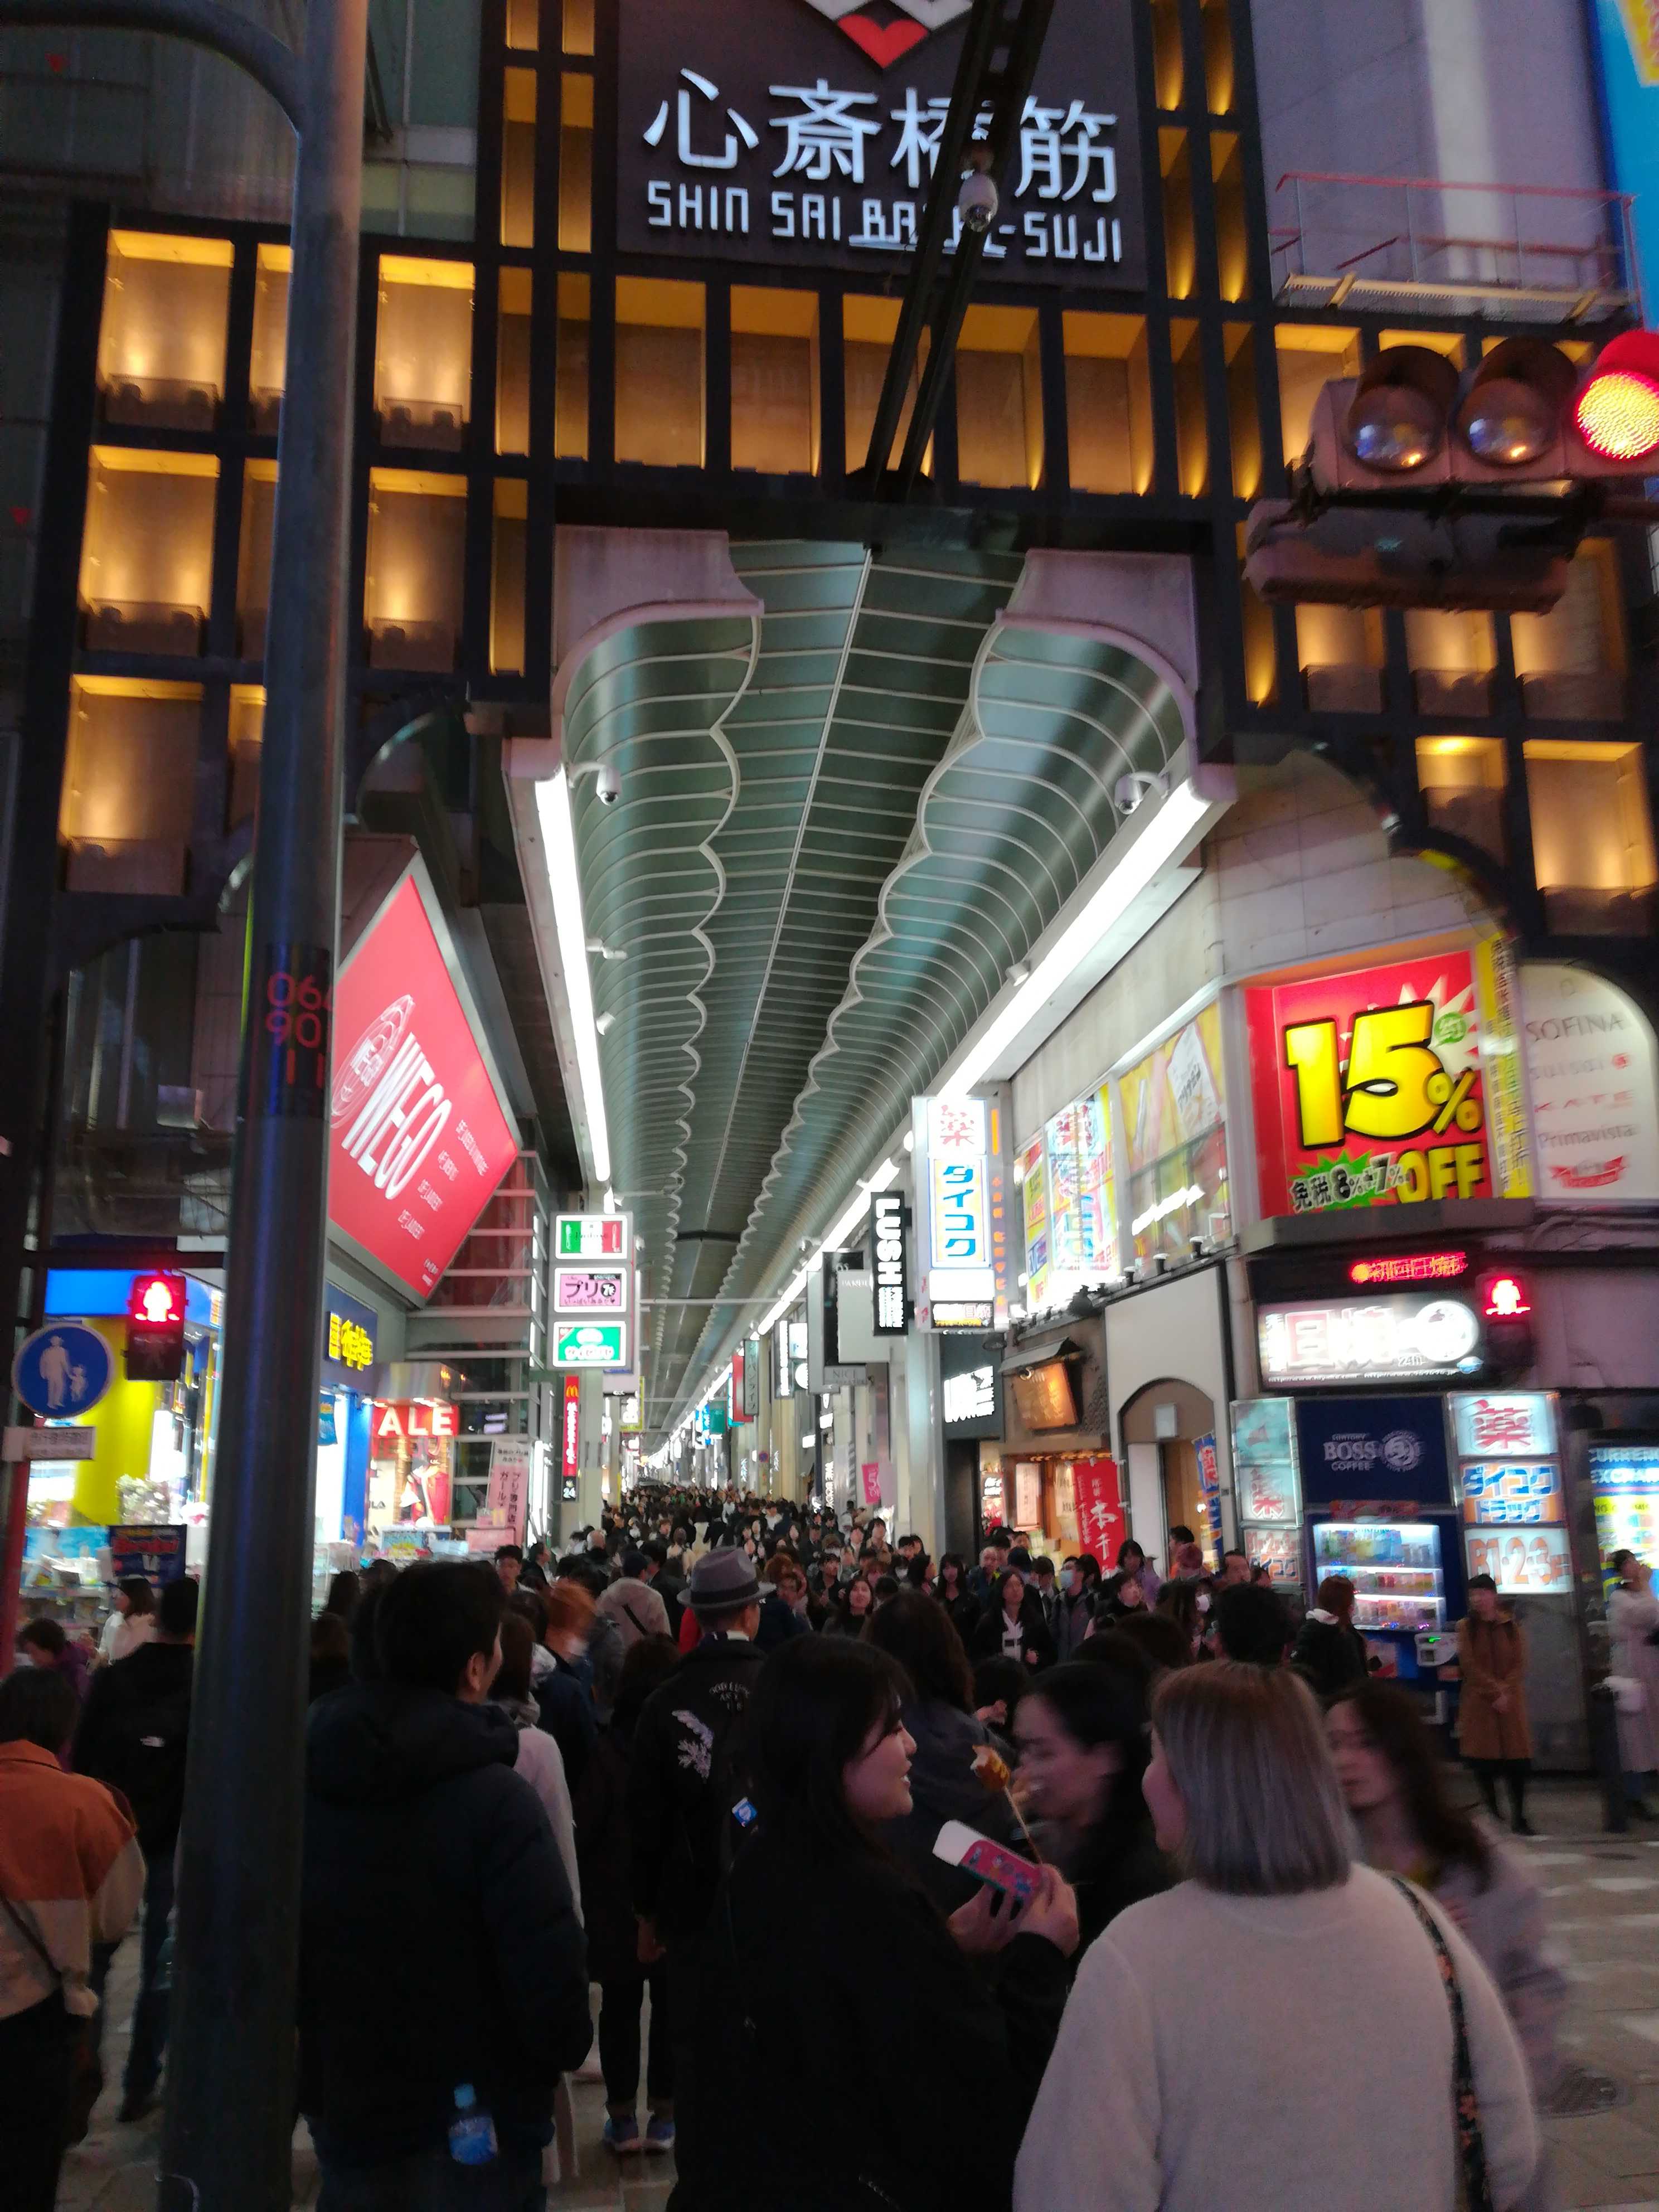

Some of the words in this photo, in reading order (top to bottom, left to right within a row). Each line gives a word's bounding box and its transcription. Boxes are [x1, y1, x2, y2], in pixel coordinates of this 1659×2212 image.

[647, 180, 749, 233] SHIN
[771, 191, 841, 241] SAI
[862, 198, 1122, 263] BA-SUJI
[1525, 1012, 1625, 1042] SOFINA
[1284, 999, 1483, 1150] 15%
[341, 1031, 453, 1200] WEGO
[1534, 1089, 1633, 1113] KATE
[1537, 1124, 1638, 1149] Primavista
[1395, 1143, 1484, 1205] OFF
[876, 1198, 903, 1285] LUSH
[1331, 1433, 1367, 1441] SUNTORY
[1473, 1398, 1532, 1451] 薬
[1323, 1440, 1379, 1461] BOSS
[1331, 1461, 1375, 1472] COFFEE
